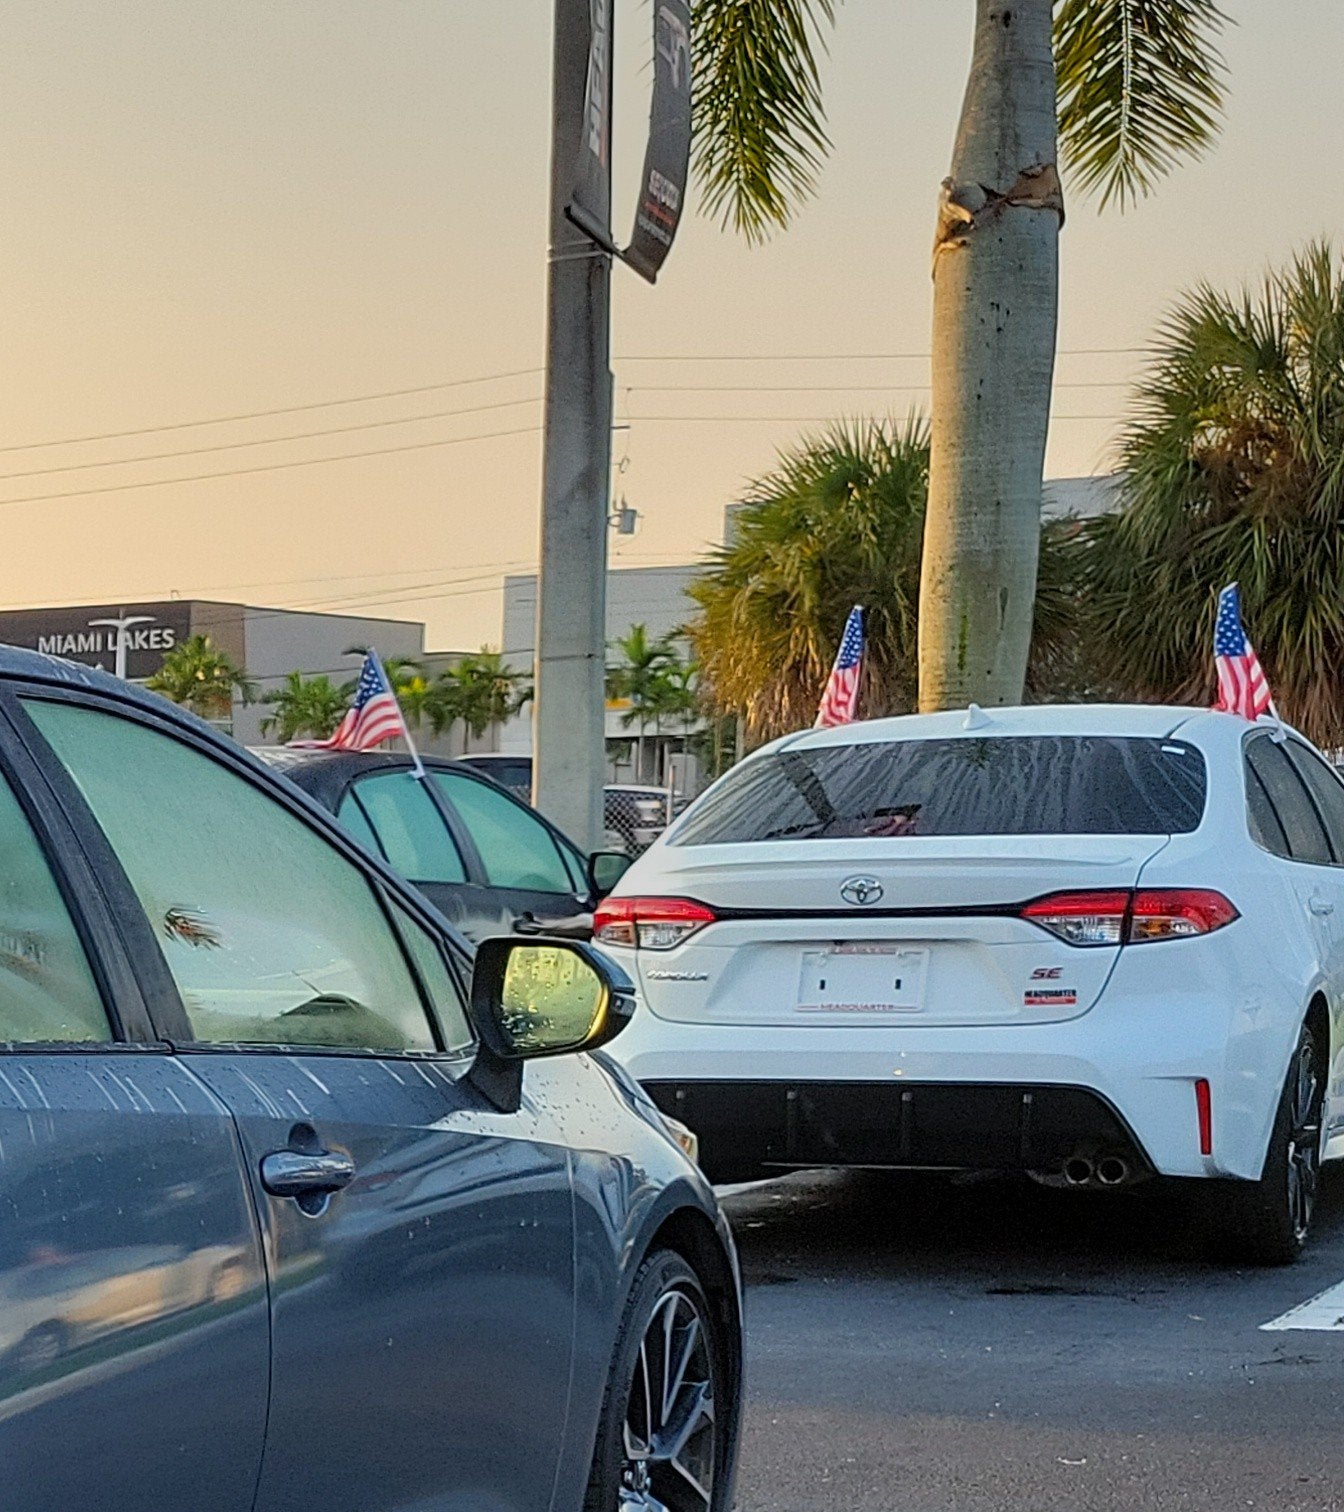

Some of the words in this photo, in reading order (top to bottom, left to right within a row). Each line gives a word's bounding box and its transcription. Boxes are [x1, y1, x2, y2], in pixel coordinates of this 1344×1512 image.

[38, 632, 102, 655] MIAMI
[107, 628, 176, 651] LAKES
[1029, 966, 1064, 980] SE
